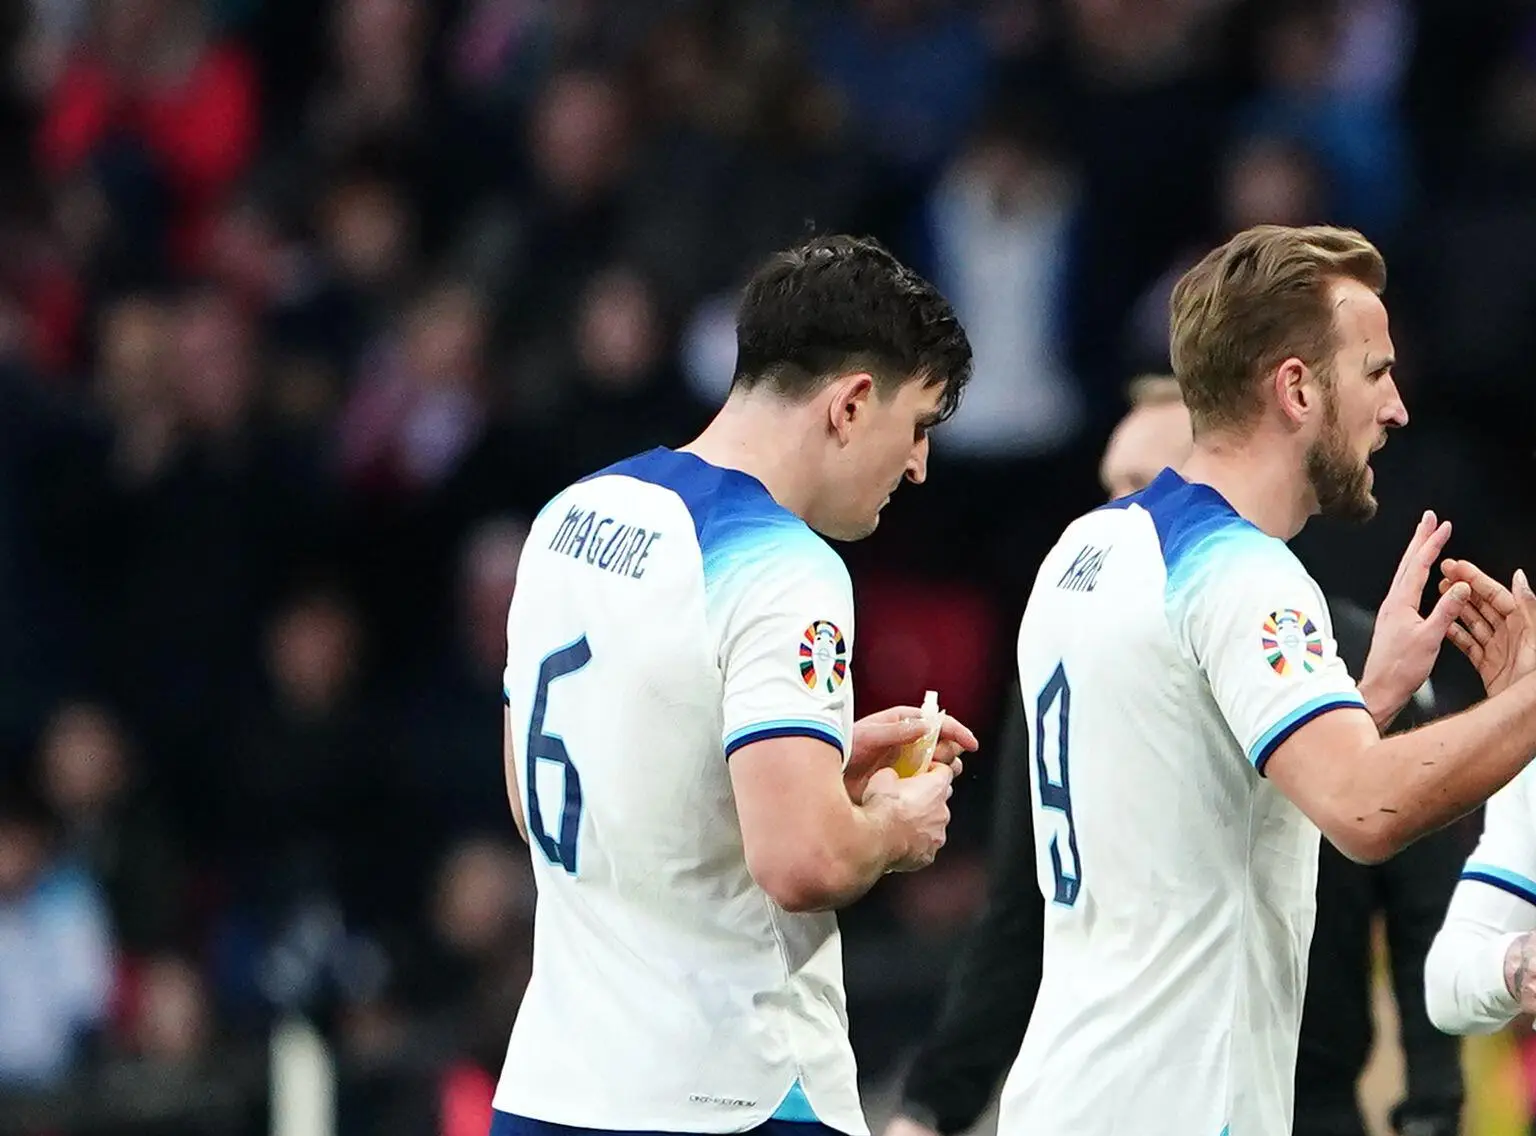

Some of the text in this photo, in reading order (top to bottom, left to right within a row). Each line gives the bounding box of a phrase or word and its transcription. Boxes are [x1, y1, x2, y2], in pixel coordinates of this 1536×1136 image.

[548, 504, 662, 579] MAGUIRE
[527, 631, 592, 878] 6
[1037, 658, 1083, 909] 9
